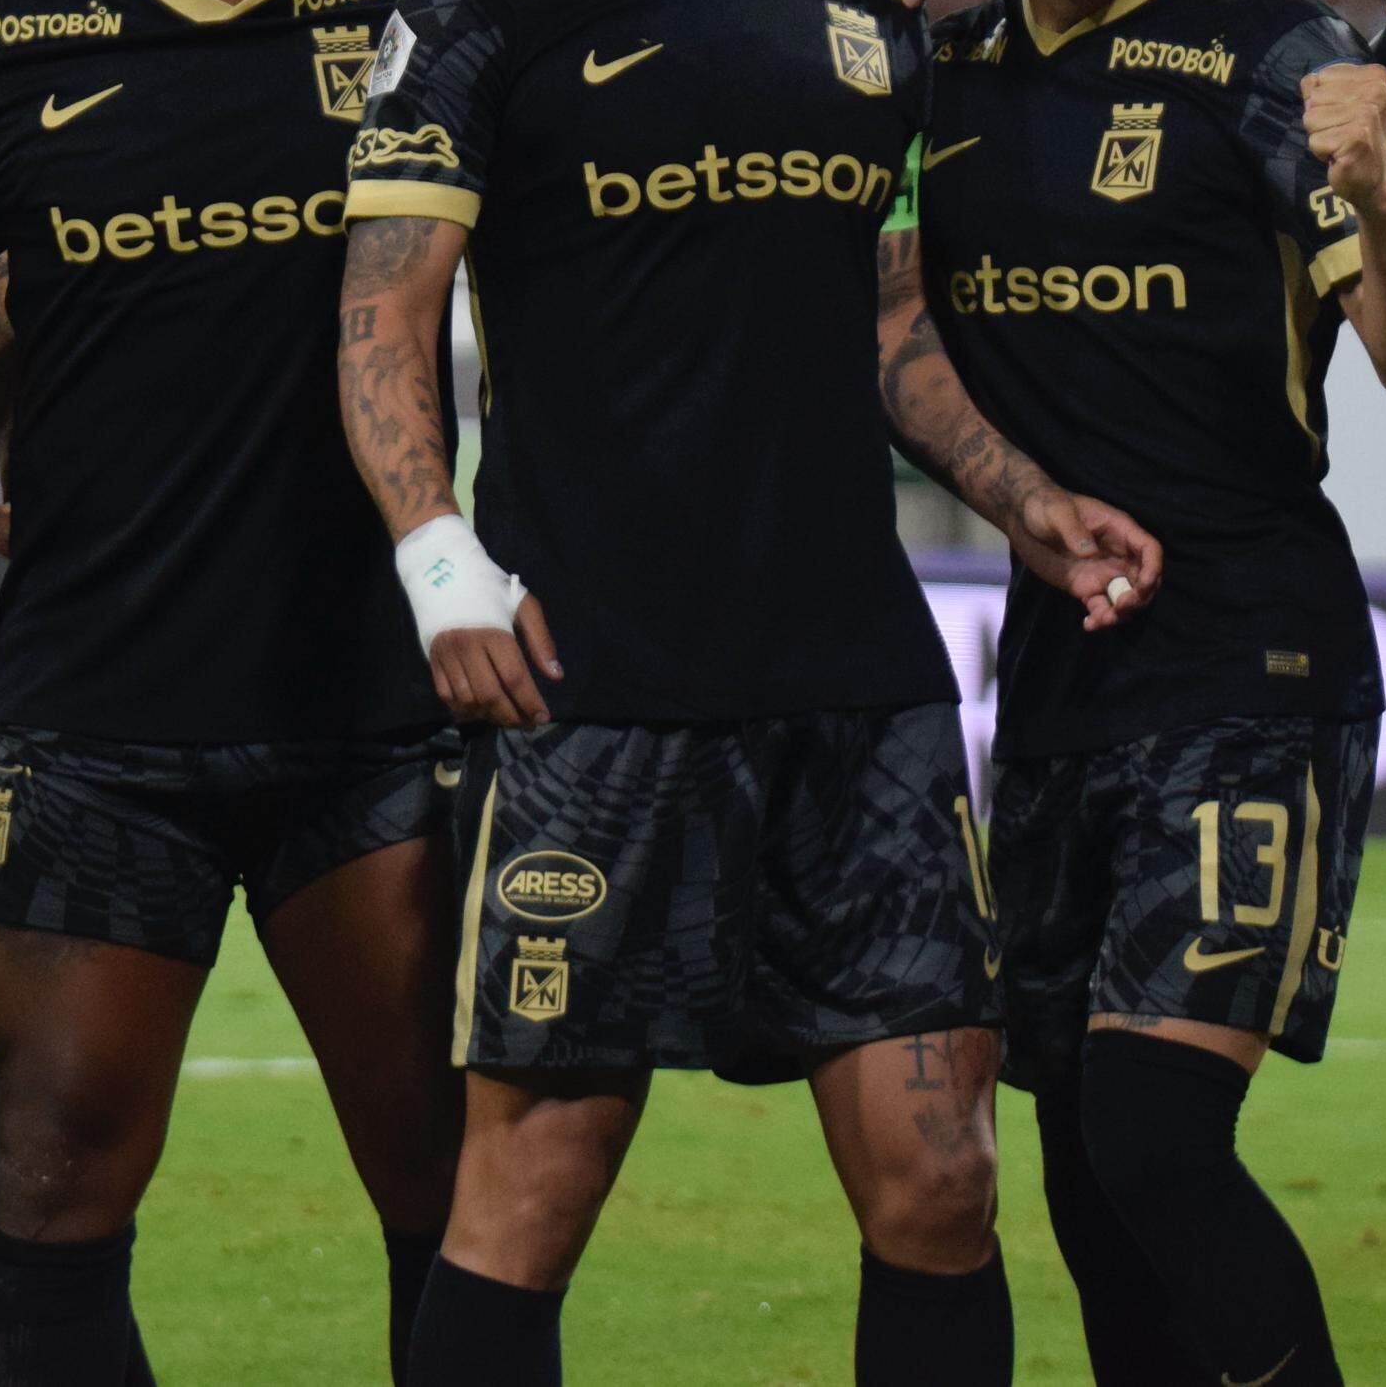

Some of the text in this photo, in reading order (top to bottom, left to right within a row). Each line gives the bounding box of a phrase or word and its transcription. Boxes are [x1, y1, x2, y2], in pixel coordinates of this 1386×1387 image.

[583, 144, 893, 217] betsson
[50, 194, 348, 264] betsso
[950, 254, 1187, 314] etsson
[505, 870, 596, 898] ARESS
[1192, 801, 1289, 927] 13
